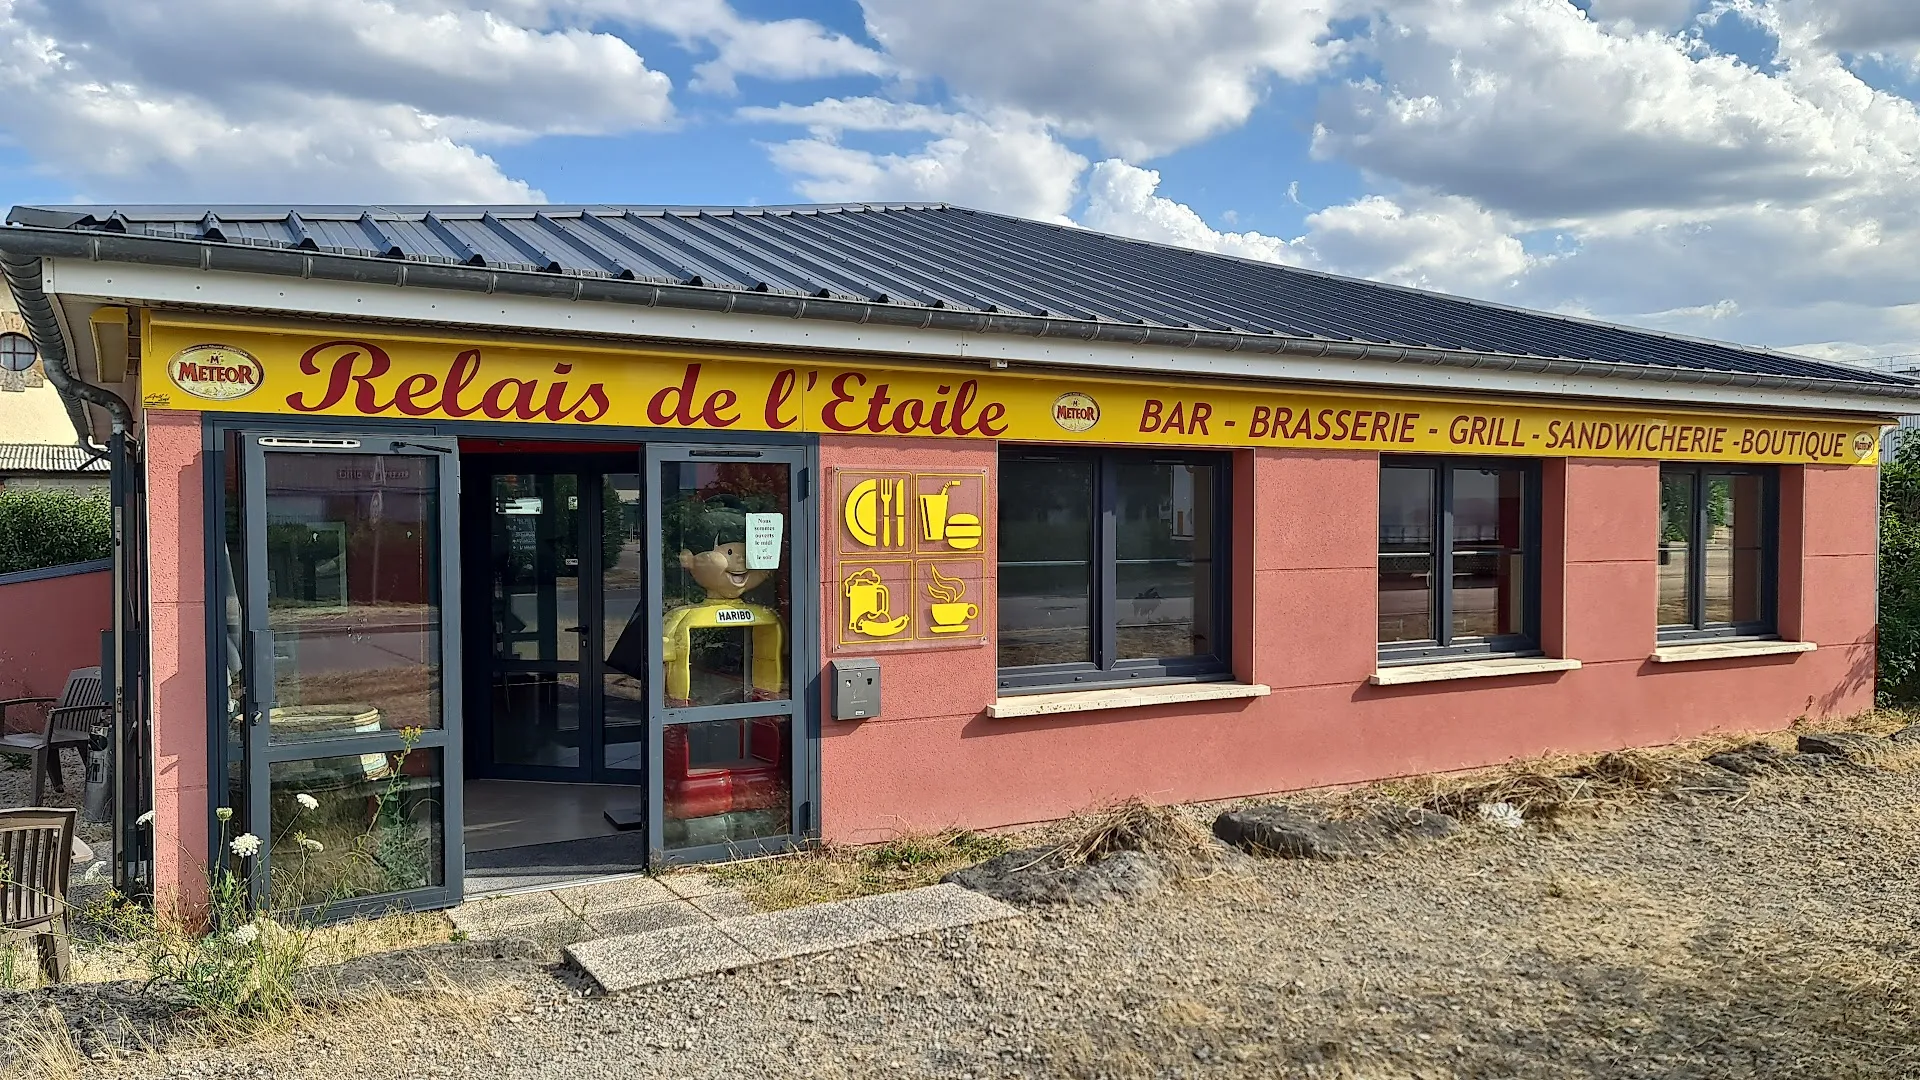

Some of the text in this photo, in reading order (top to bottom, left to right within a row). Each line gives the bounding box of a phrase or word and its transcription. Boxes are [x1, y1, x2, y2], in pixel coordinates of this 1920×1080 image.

[178, 361, 255, 385] METEOR
[286, 340, 1009, 436] Relais de l'Etoile
[1056, 405, 1095, 421] METEOR
[1139, 399, 1213, 436] BAR
[1248, 406, 1420, 443] BRASSERIE
[1449, 415, 1526, 447] GRILL
[1545, 420, 1727, 453] SANDWICHERIE
[718, 610, 751, 621] HARIBO
